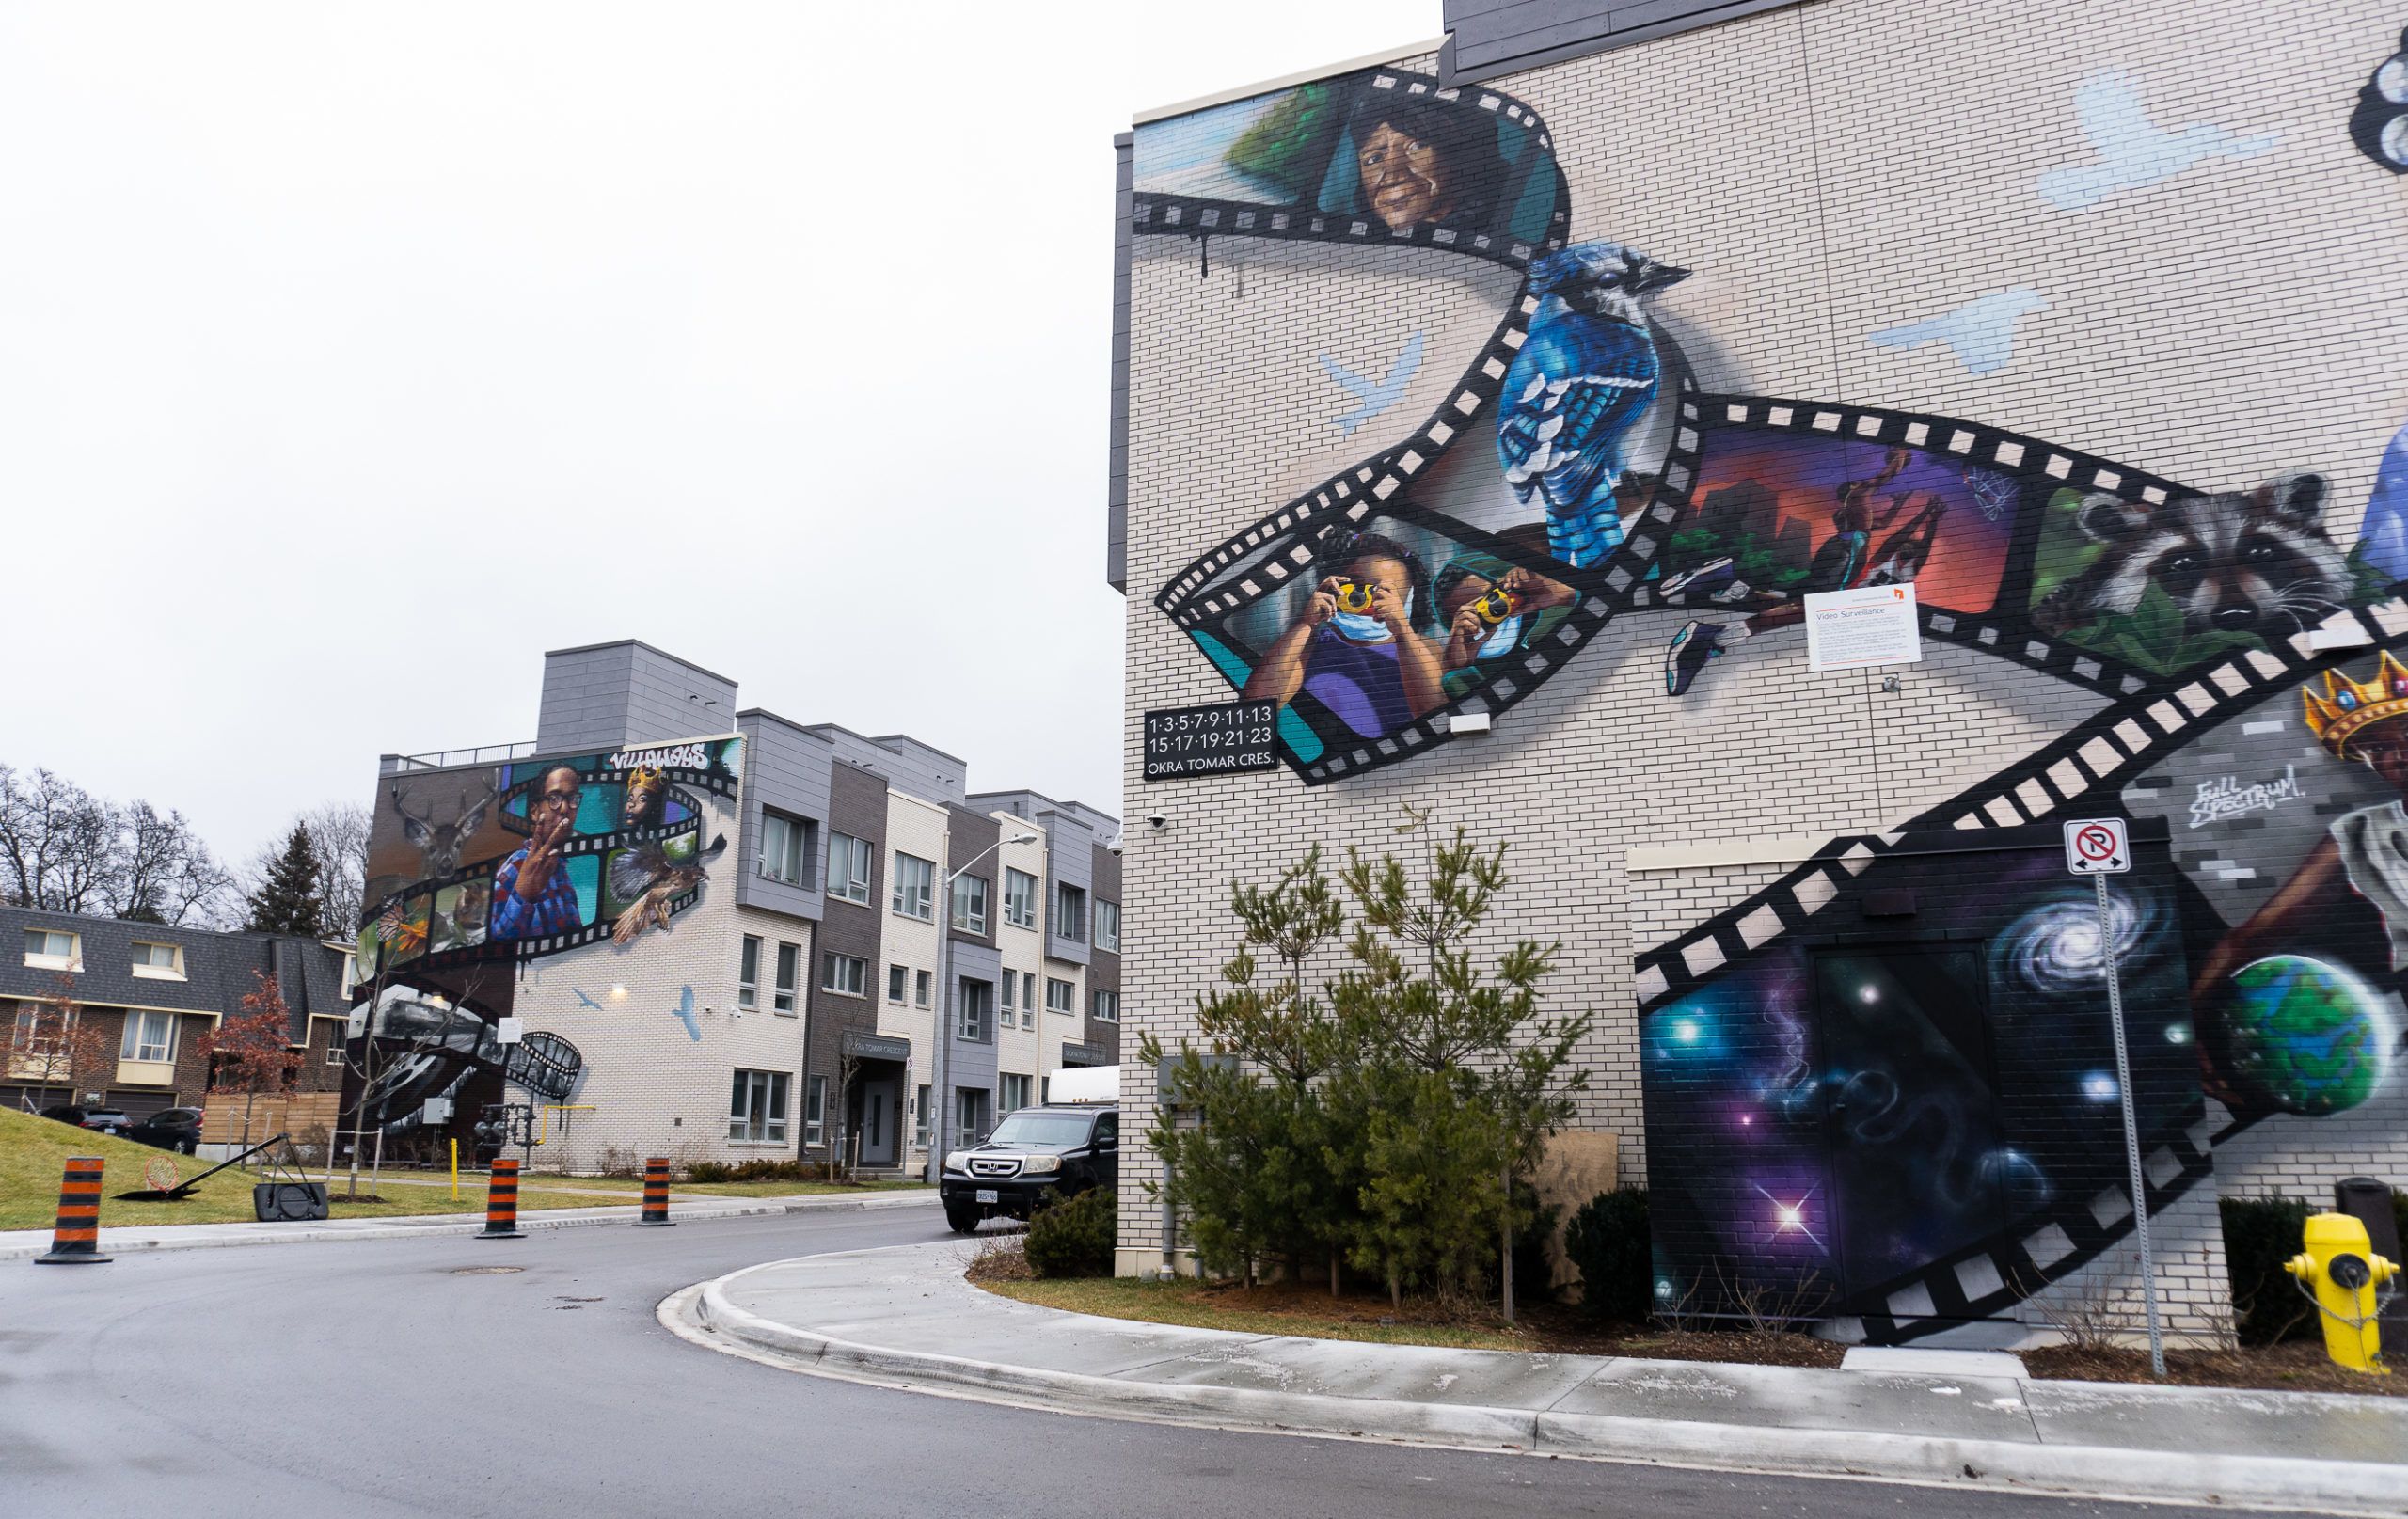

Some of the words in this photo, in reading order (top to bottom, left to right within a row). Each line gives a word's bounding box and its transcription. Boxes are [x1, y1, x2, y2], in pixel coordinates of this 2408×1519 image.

[1816, 612, 1838, 621] Video
[1841, 608, 1886, 618] Surveillance
[1148, 761, 1184, 775] OKRA
[1187, 756, 1236, 771] TOMAR
[1239, 752, 1275, 766] CRES.
